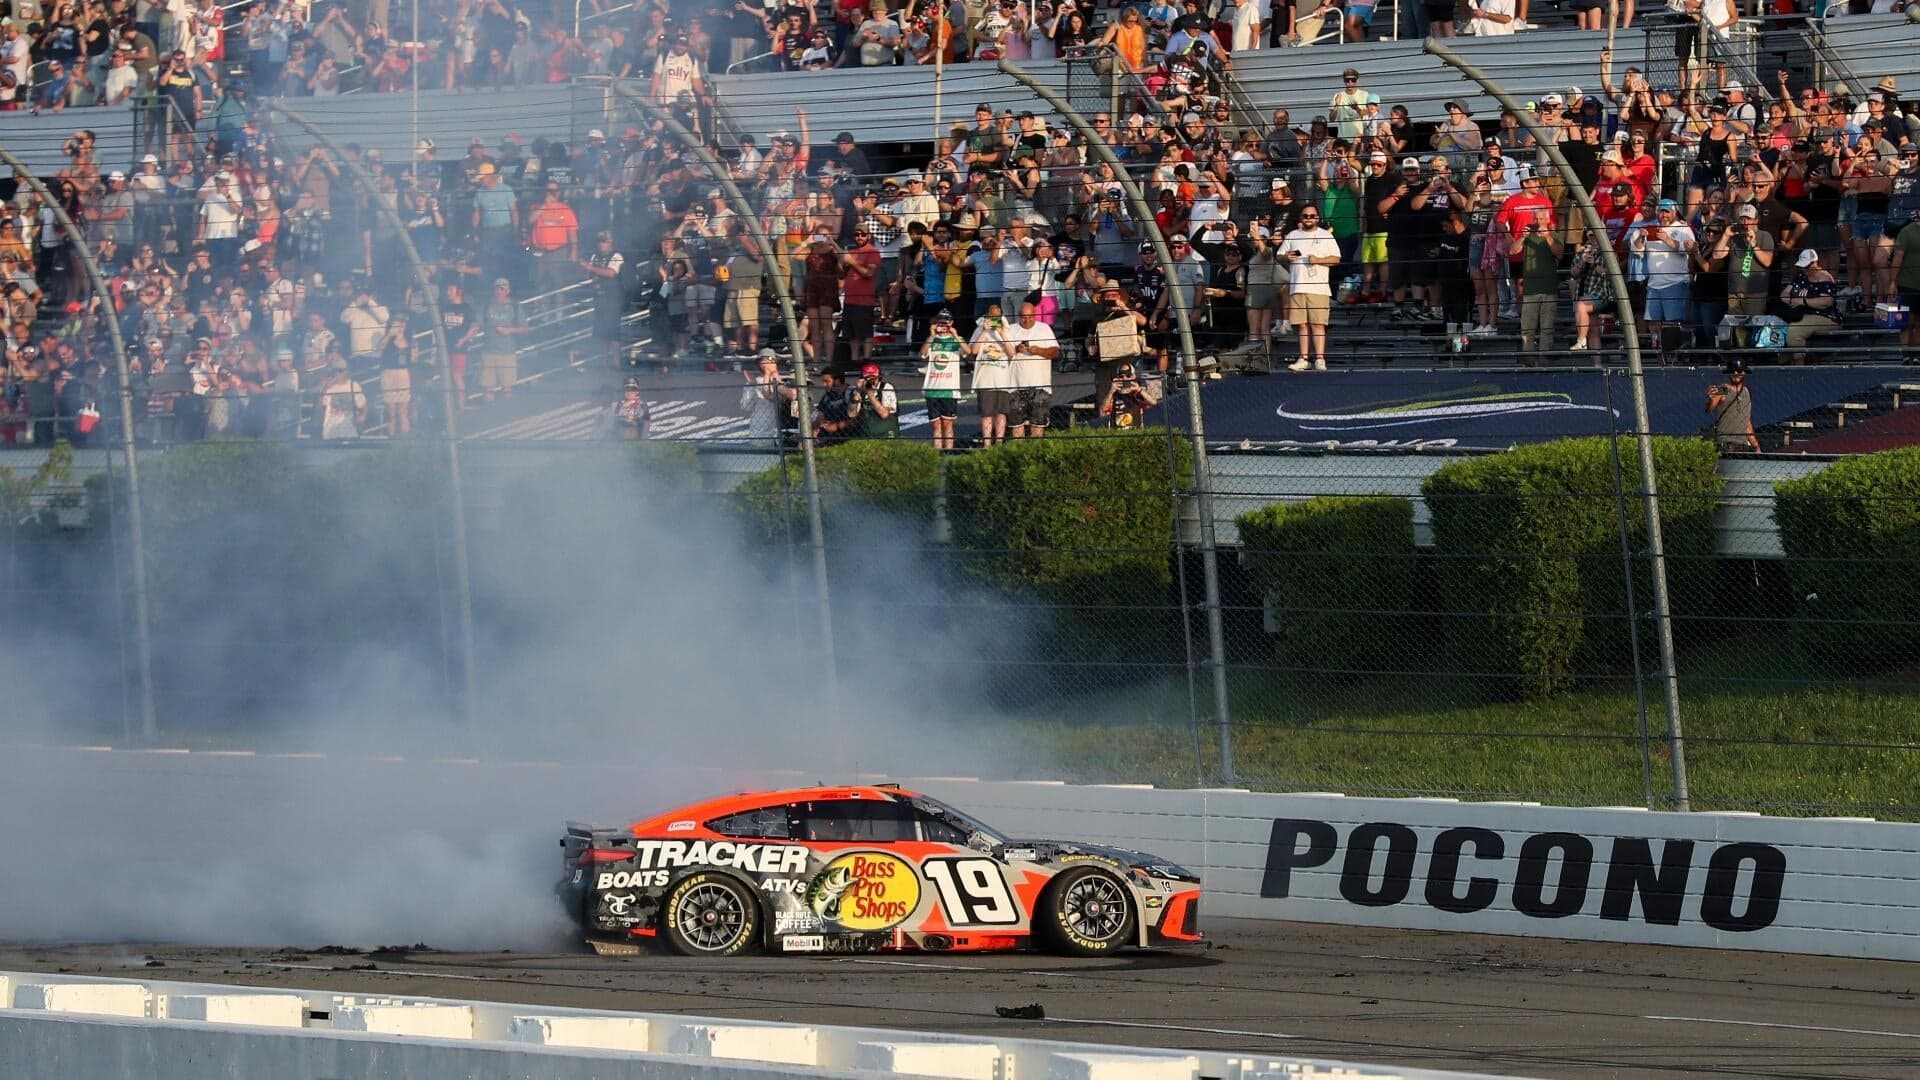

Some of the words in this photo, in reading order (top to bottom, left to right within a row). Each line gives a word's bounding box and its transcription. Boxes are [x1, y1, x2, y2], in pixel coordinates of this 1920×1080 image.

[668, 67, 690, 81] ally
[635, 841, 810, 873] TRACKER
[851, 856, 895, 878] Bass
[597, 870, 669, 890] BOATS
[760, 878, 806, 893] ATVs
[1259, 818, 1787, 932] POCONO
[852, 877, 886, 898] Pro
[921, 858, 1019, 925] 19
[1161, 880, 1173, 893] 19
[668, 874, 706, 928] GOODYEAR
[853, 897, 907, 922] Shops
[775, 911, 794, 919] BLACK
[775, 919, 812, 929] COFFEE
[1058, 912, 1107, 949] GOODYEAR
[787, 938, 810, 948] Mobil
